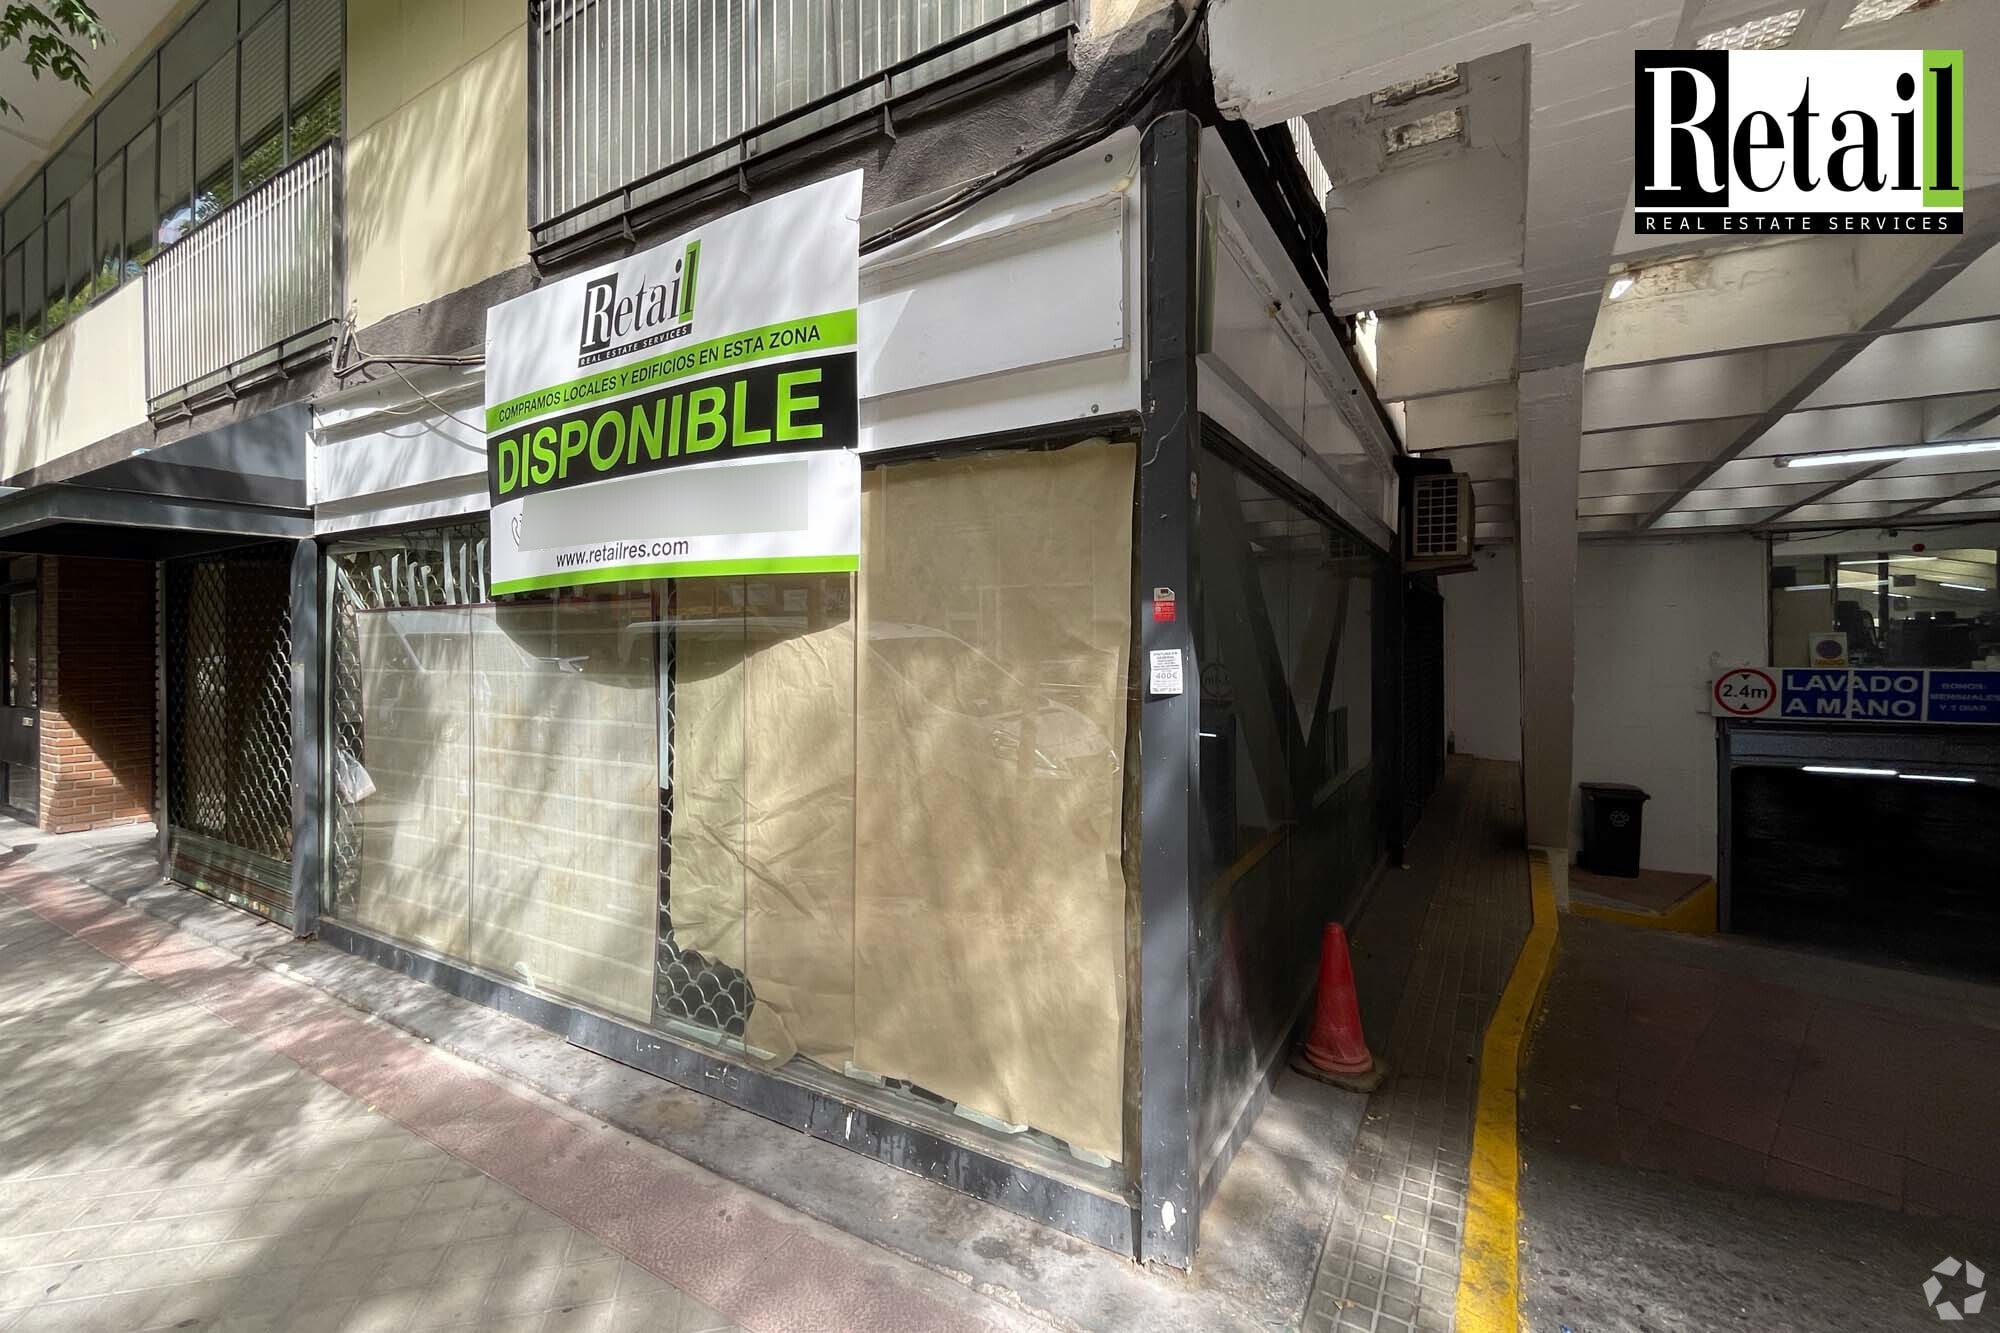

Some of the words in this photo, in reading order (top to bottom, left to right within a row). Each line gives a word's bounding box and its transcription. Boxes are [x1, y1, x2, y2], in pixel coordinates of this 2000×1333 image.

[582, 248, 697, 348] Retail
[580, 354, 601, 366] REAL
[605, 341, 639, 358] ESTATE
[642, 325, 688, 347] SERVICES
[498, 391, 561, 422] COMPRAMOS
[563, 376, 617, 402] LOCALES
[620, 373, 629, 387] Y
[631, 353, 695, 384] EDIFICIOS
[700, 346, 719, 365] EN
[723, 336, 765, 360] ESTA
[769, 325, 821, 350] ZONA
[498, 367, 824, 495] DISPONIBLE
[556, 540, 689, 568] www.retailres.com
[1722, 684, 1768, 699] 2.4m
[1786, 674, 1919, 693] LAVADO
[1785, 698, 1810, 713] A
[1817, 699, 1917, 717] MANO
